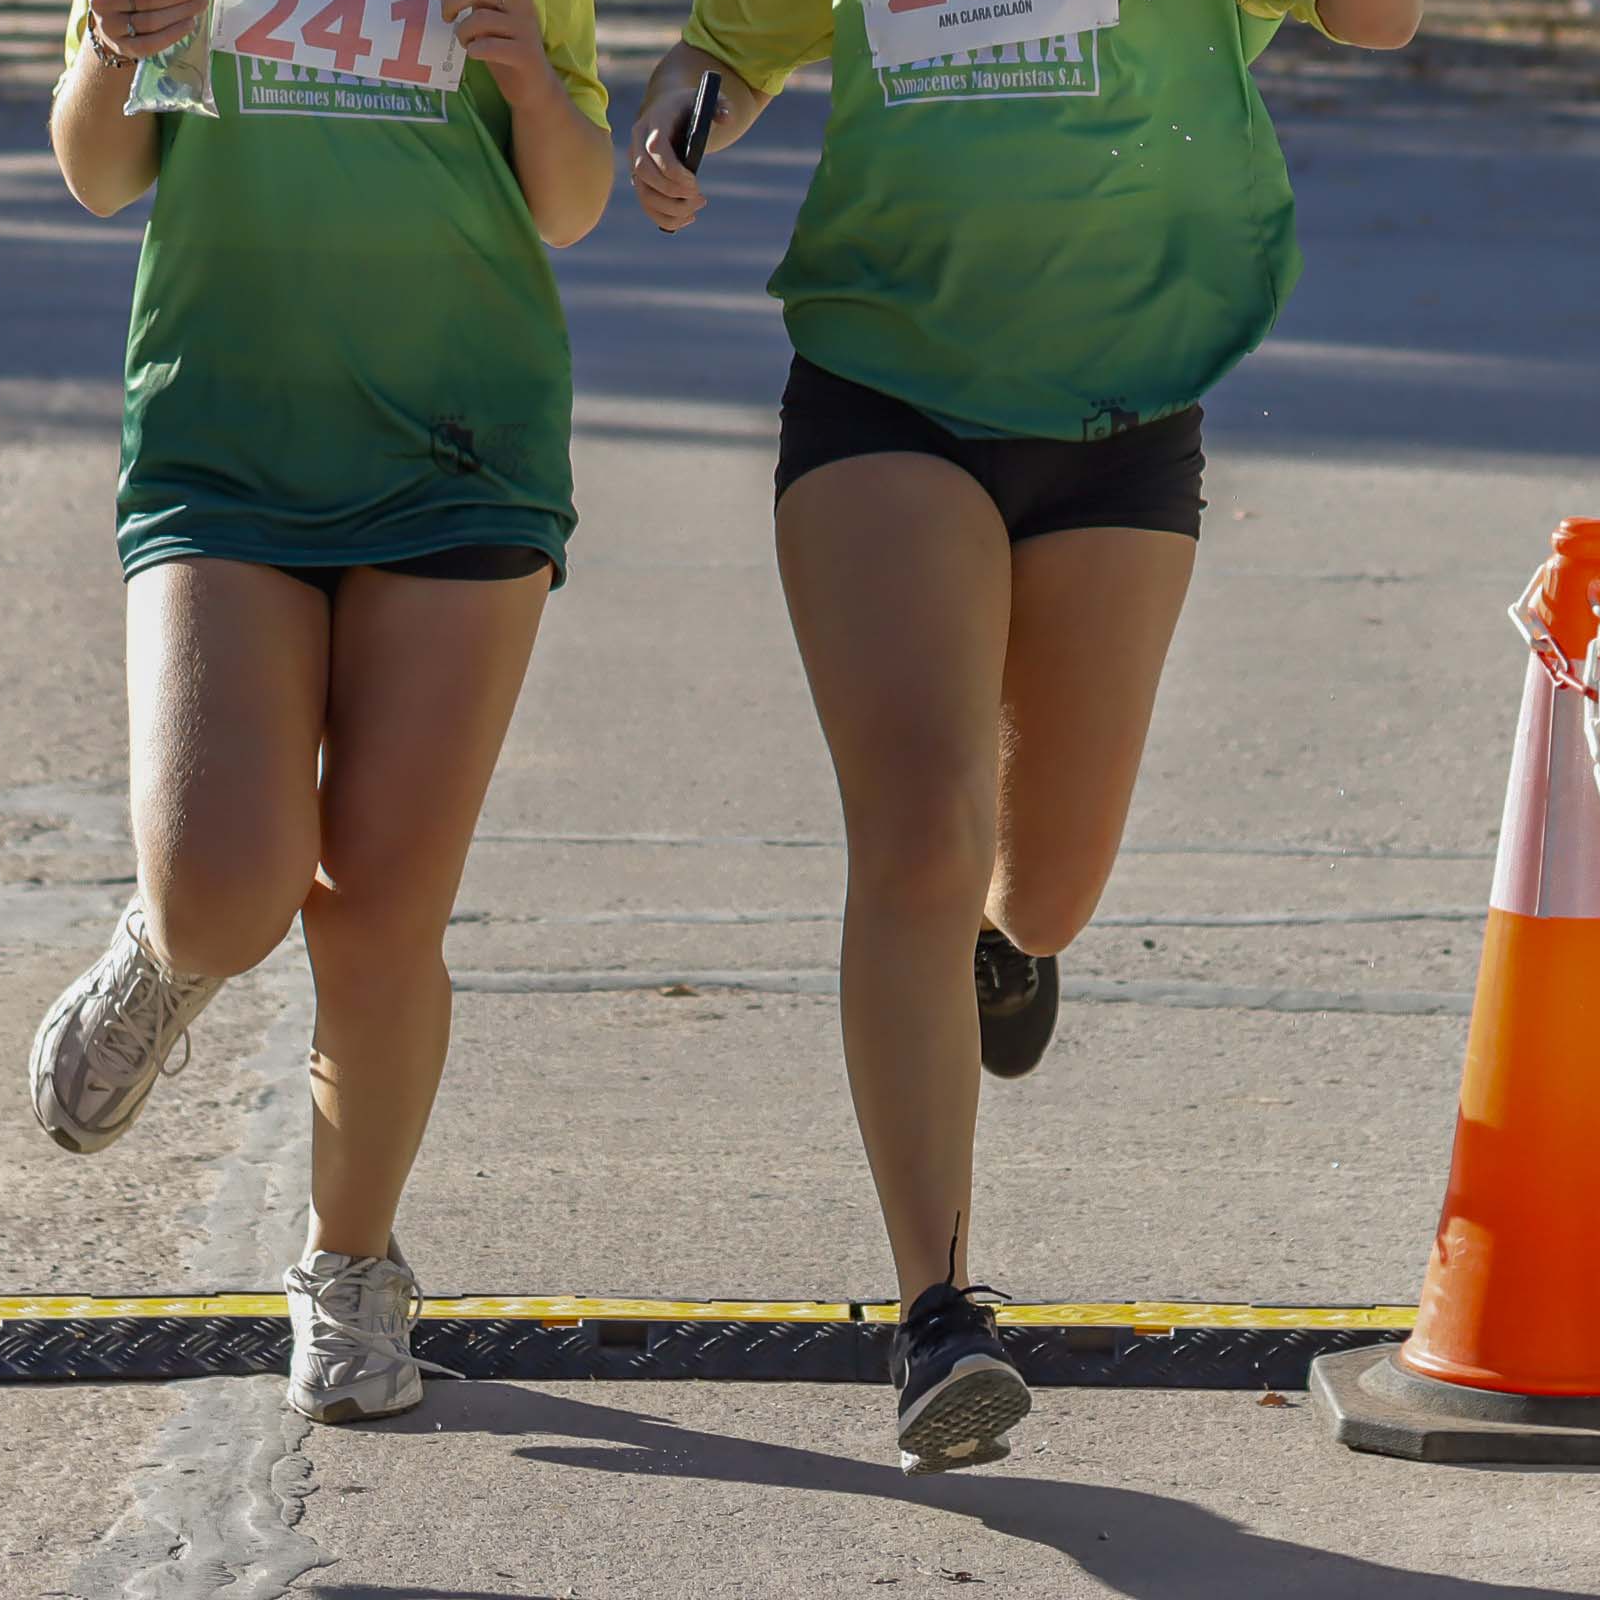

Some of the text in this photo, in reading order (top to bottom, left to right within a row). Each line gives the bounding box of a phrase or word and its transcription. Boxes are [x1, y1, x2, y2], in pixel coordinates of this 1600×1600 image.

[939, 0, 1033, 28] ANA CLARA CALAÓN
[892, 67, 1088, 95] Almacenes Mayoristas S.A.
[251, 86, 330, 106] Almacenes
[334, 90, 412, 112] Mayoristas
